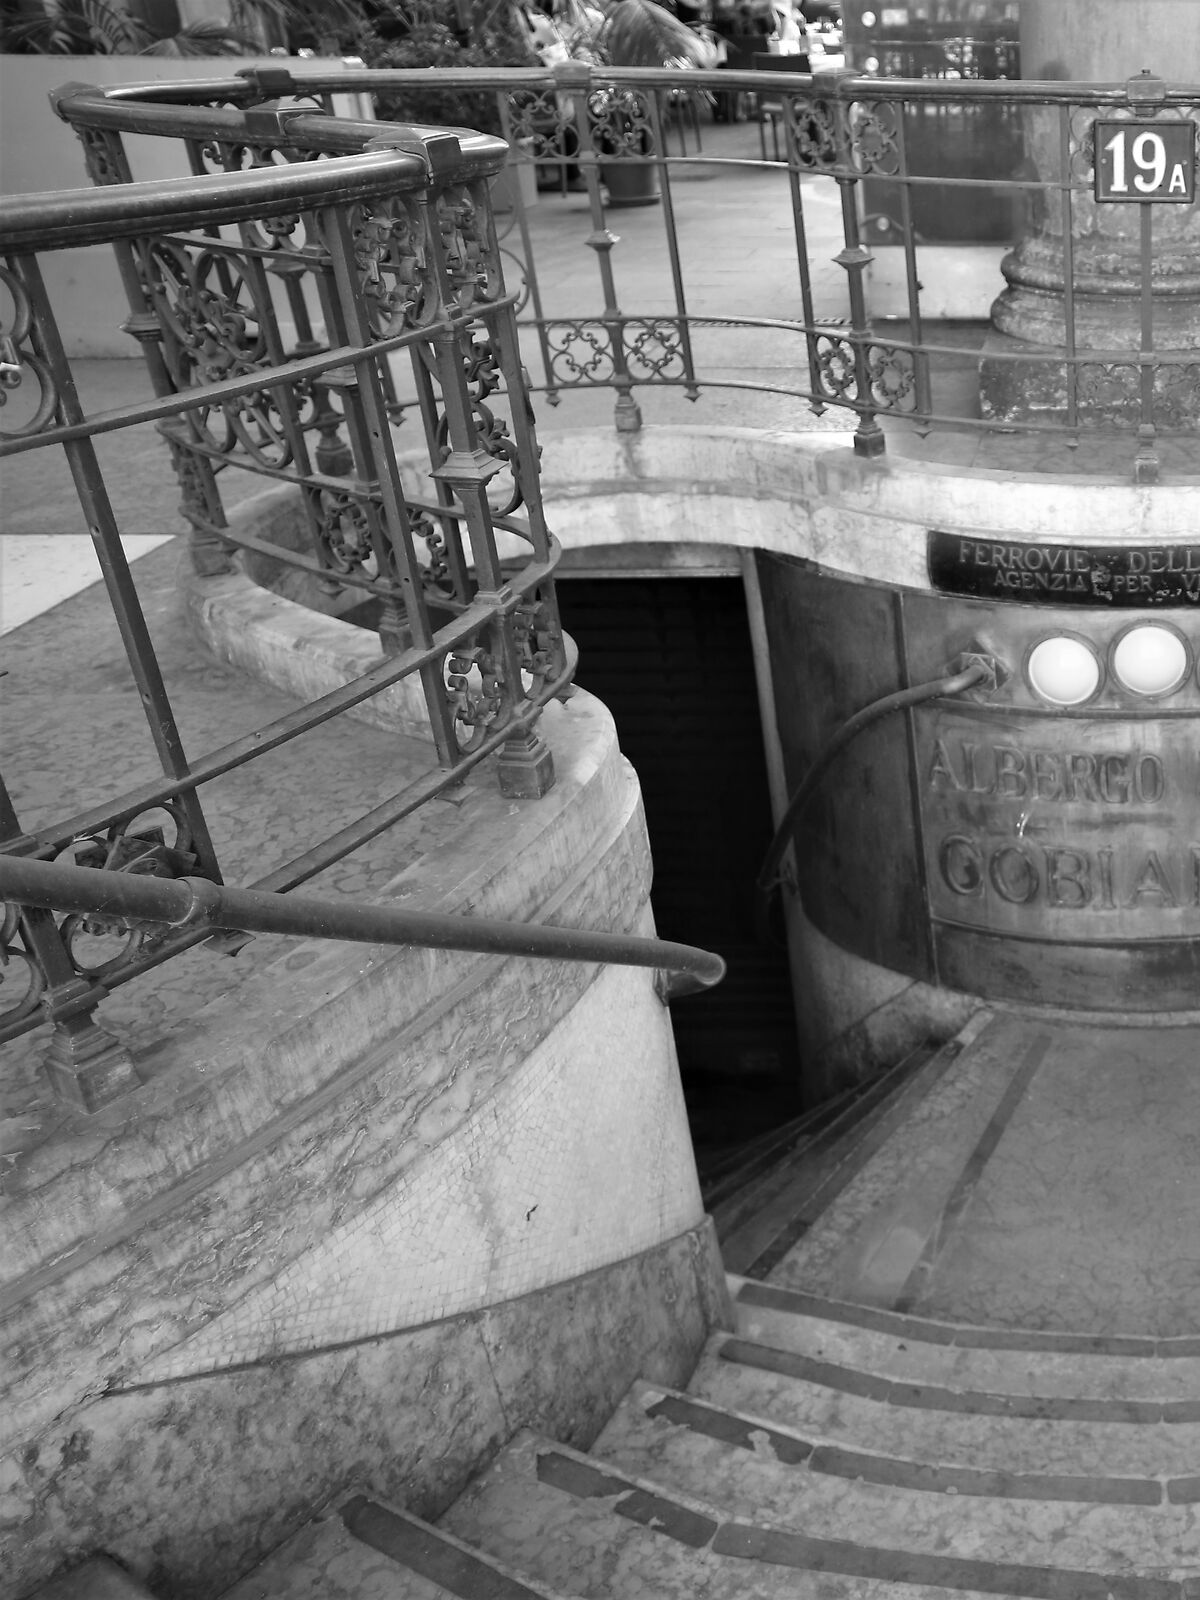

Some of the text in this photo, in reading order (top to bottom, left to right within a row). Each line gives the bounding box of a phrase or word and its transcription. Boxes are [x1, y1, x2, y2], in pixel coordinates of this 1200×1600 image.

[960, 540, 1091, 572] FERROVIE
[994, 569, 1088, 592] AGENZIA
[1113, 574, 1152, 593] PER
[930, 739, 1165, 804] ALBERGO
